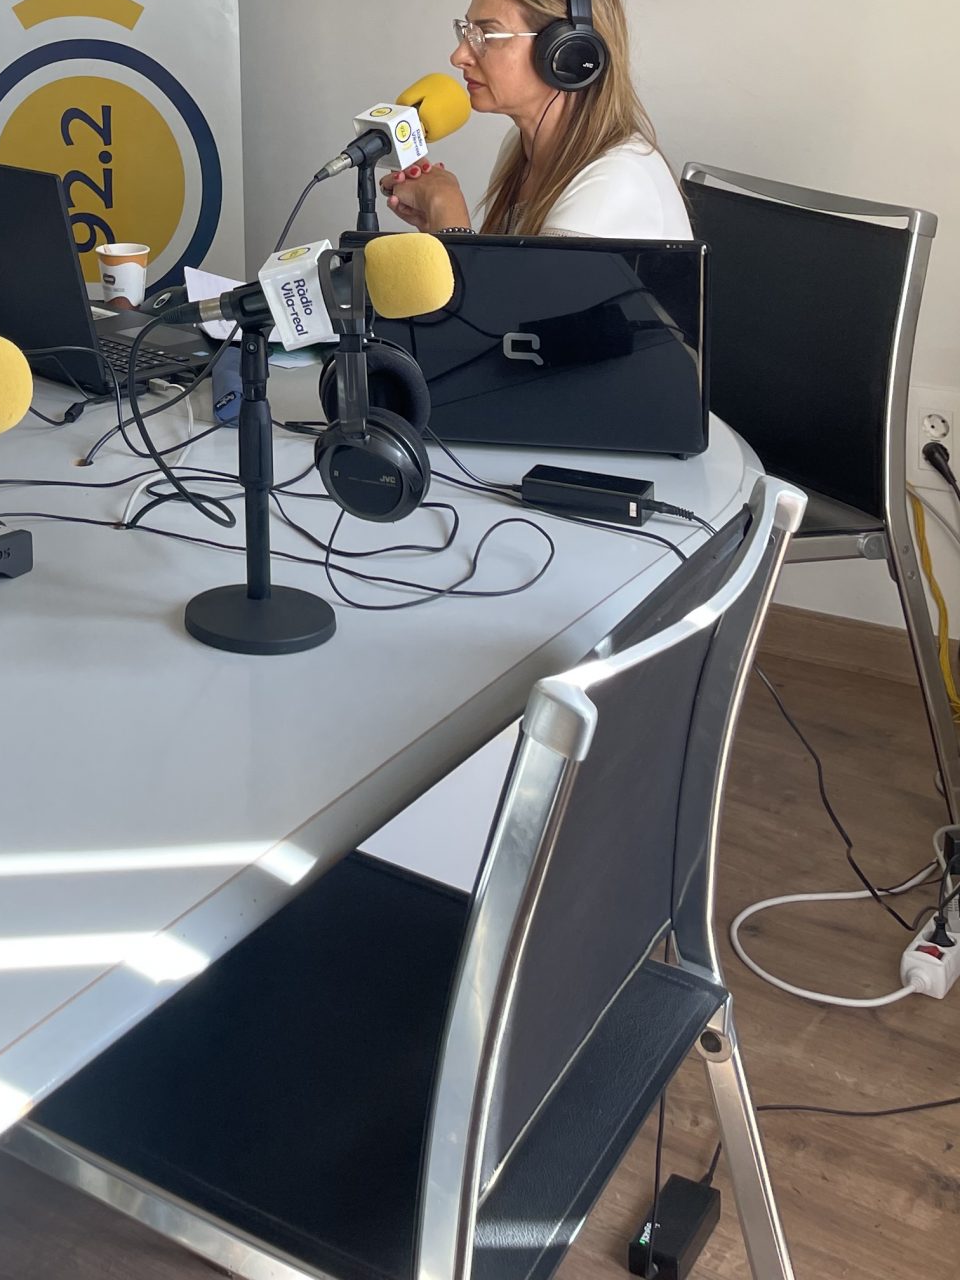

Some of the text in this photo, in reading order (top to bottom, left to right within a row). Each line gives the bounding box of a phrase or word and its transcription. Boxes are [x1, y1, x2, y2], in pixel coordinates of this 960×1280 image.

[60, 105, 116, 253] 92.2
[281, 282, 309, 336] Vila-real
[293, 278, 313, 316] Ràdio
[380, 475, 396, 484] JVC
